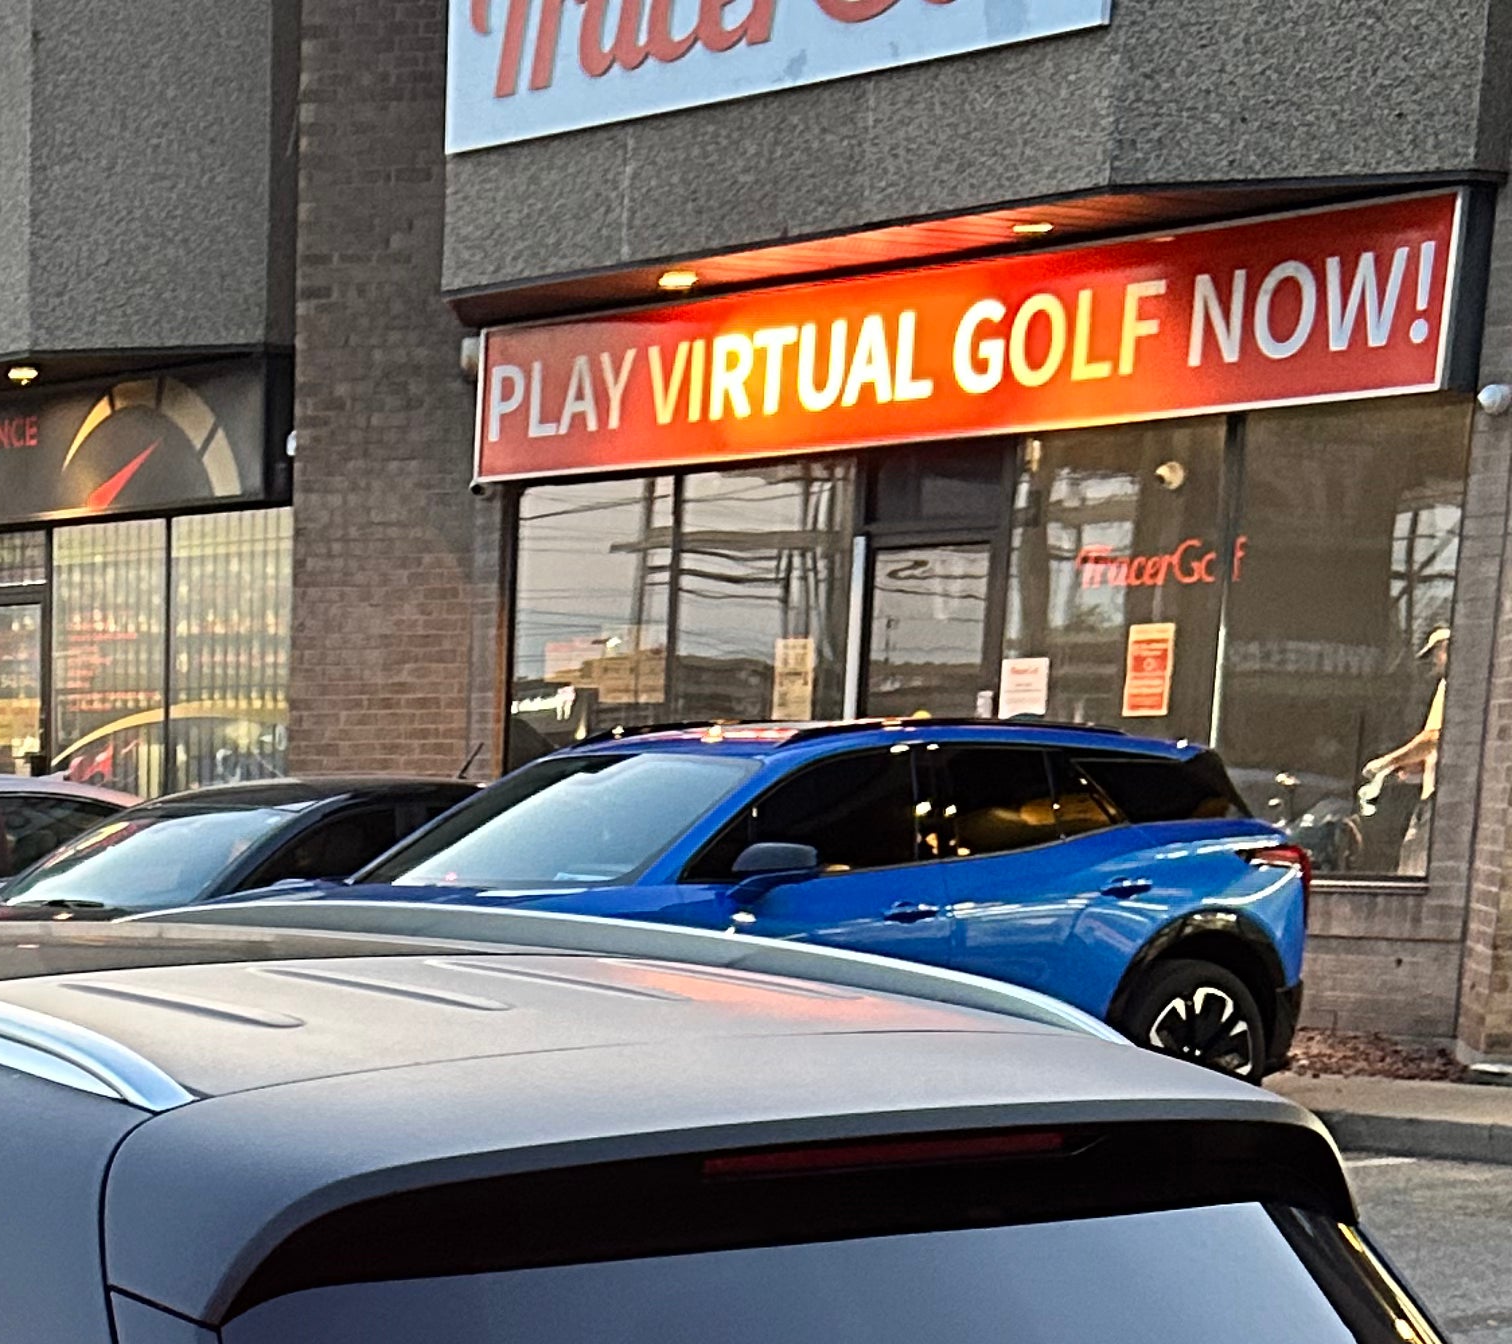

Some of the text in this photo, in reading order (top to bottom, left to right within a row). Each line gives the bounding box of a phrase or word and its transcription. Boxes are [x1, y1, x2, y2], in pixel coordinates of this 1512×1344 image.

[487, 240, 1436, 442] PLAY VIRTUAL GOLF NOW!
